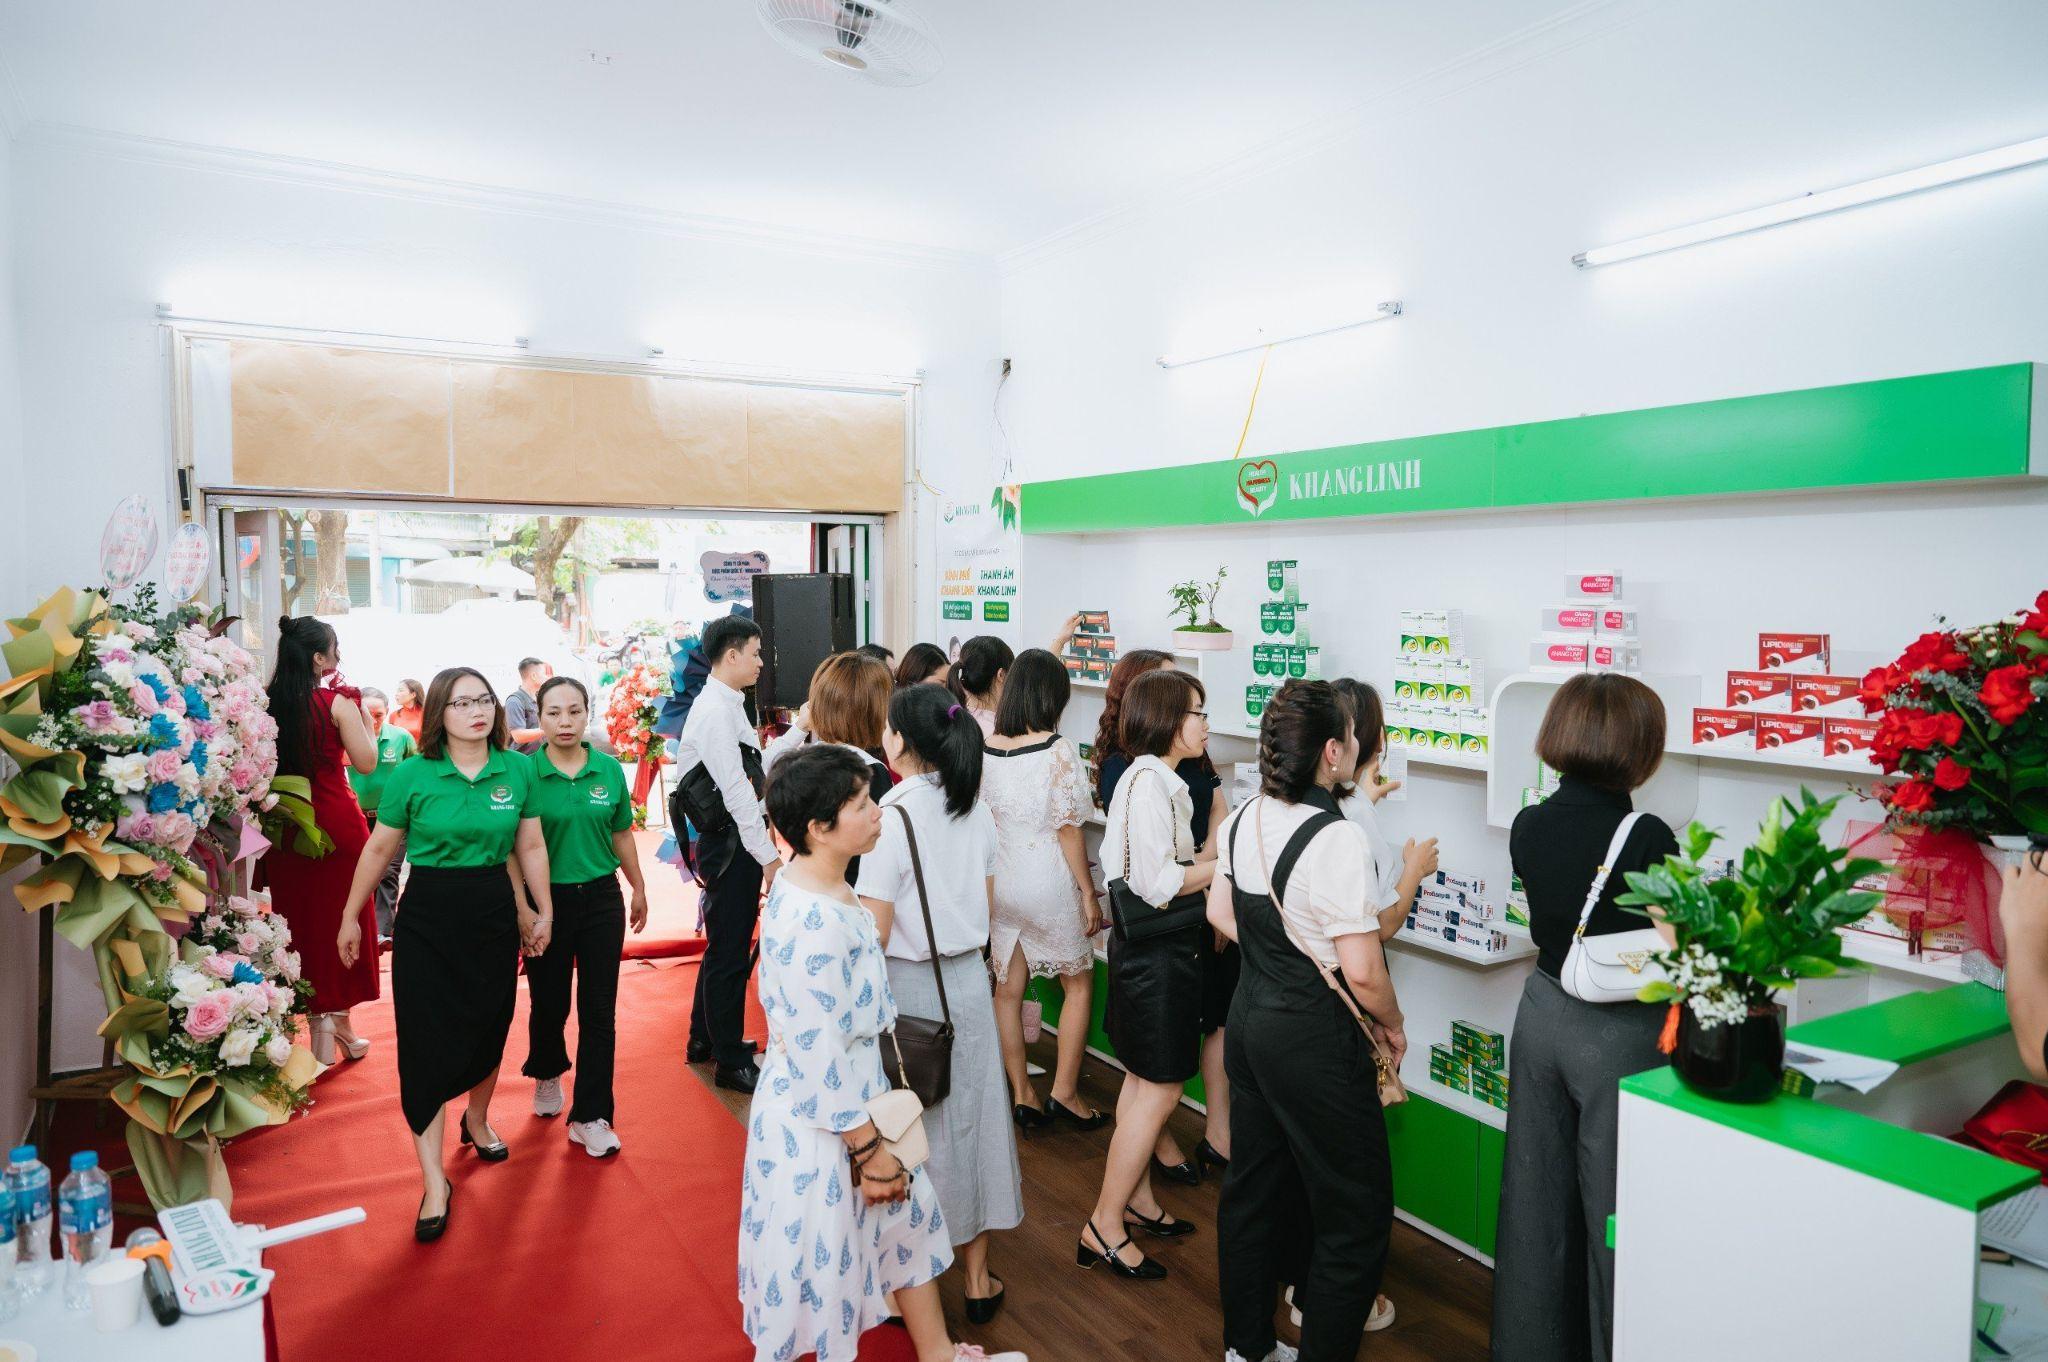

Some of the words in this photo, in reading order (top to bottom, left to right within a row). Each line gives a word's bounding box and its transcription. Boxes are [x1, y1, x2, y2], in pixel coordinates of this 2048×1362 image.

[980, 569, 1002, 580] THANH
[977, 585, 1000, 596] KHANG
[1001, 585, 1017, 596] LINH
